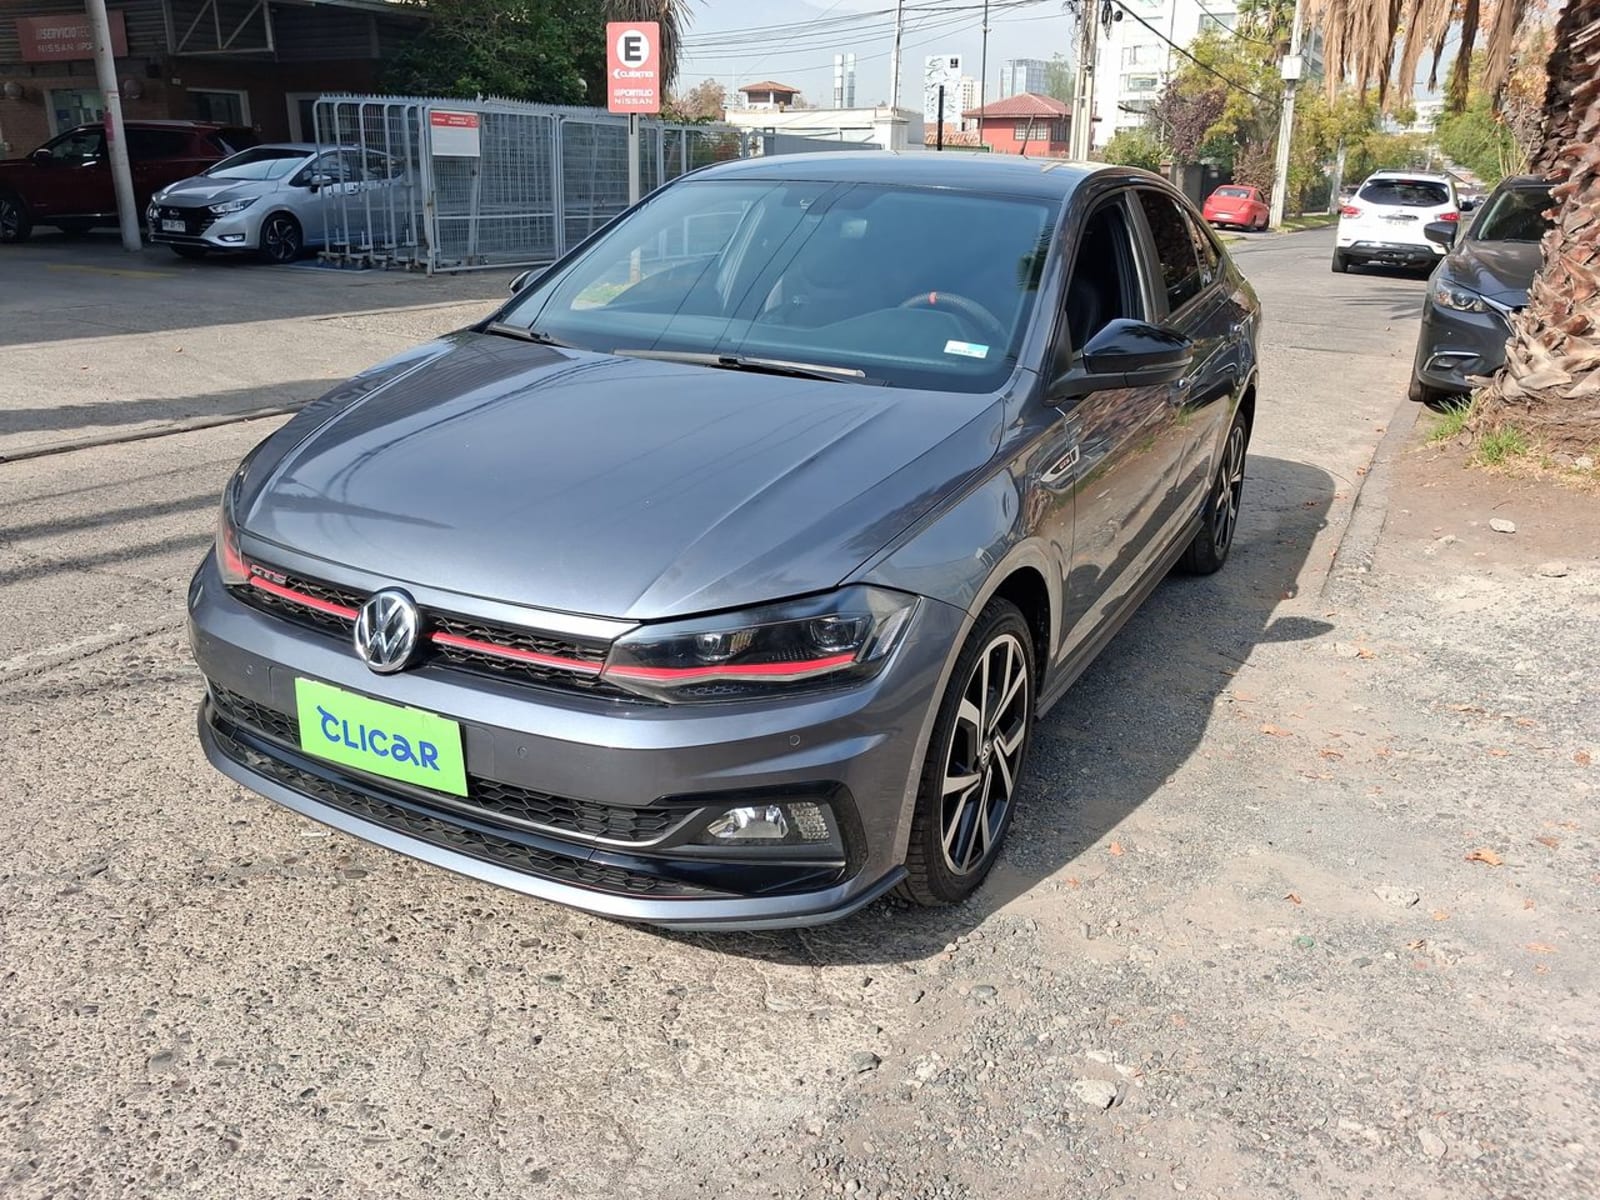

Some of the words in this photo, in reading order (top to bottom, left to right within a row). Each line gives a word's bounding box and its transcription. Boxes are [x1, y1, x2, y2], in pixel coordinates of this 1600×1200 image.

[37, 42, 74, 53] NISSAN
[624, 36, 642, 61] E
[614, 97, 653, 105] NISSAN
